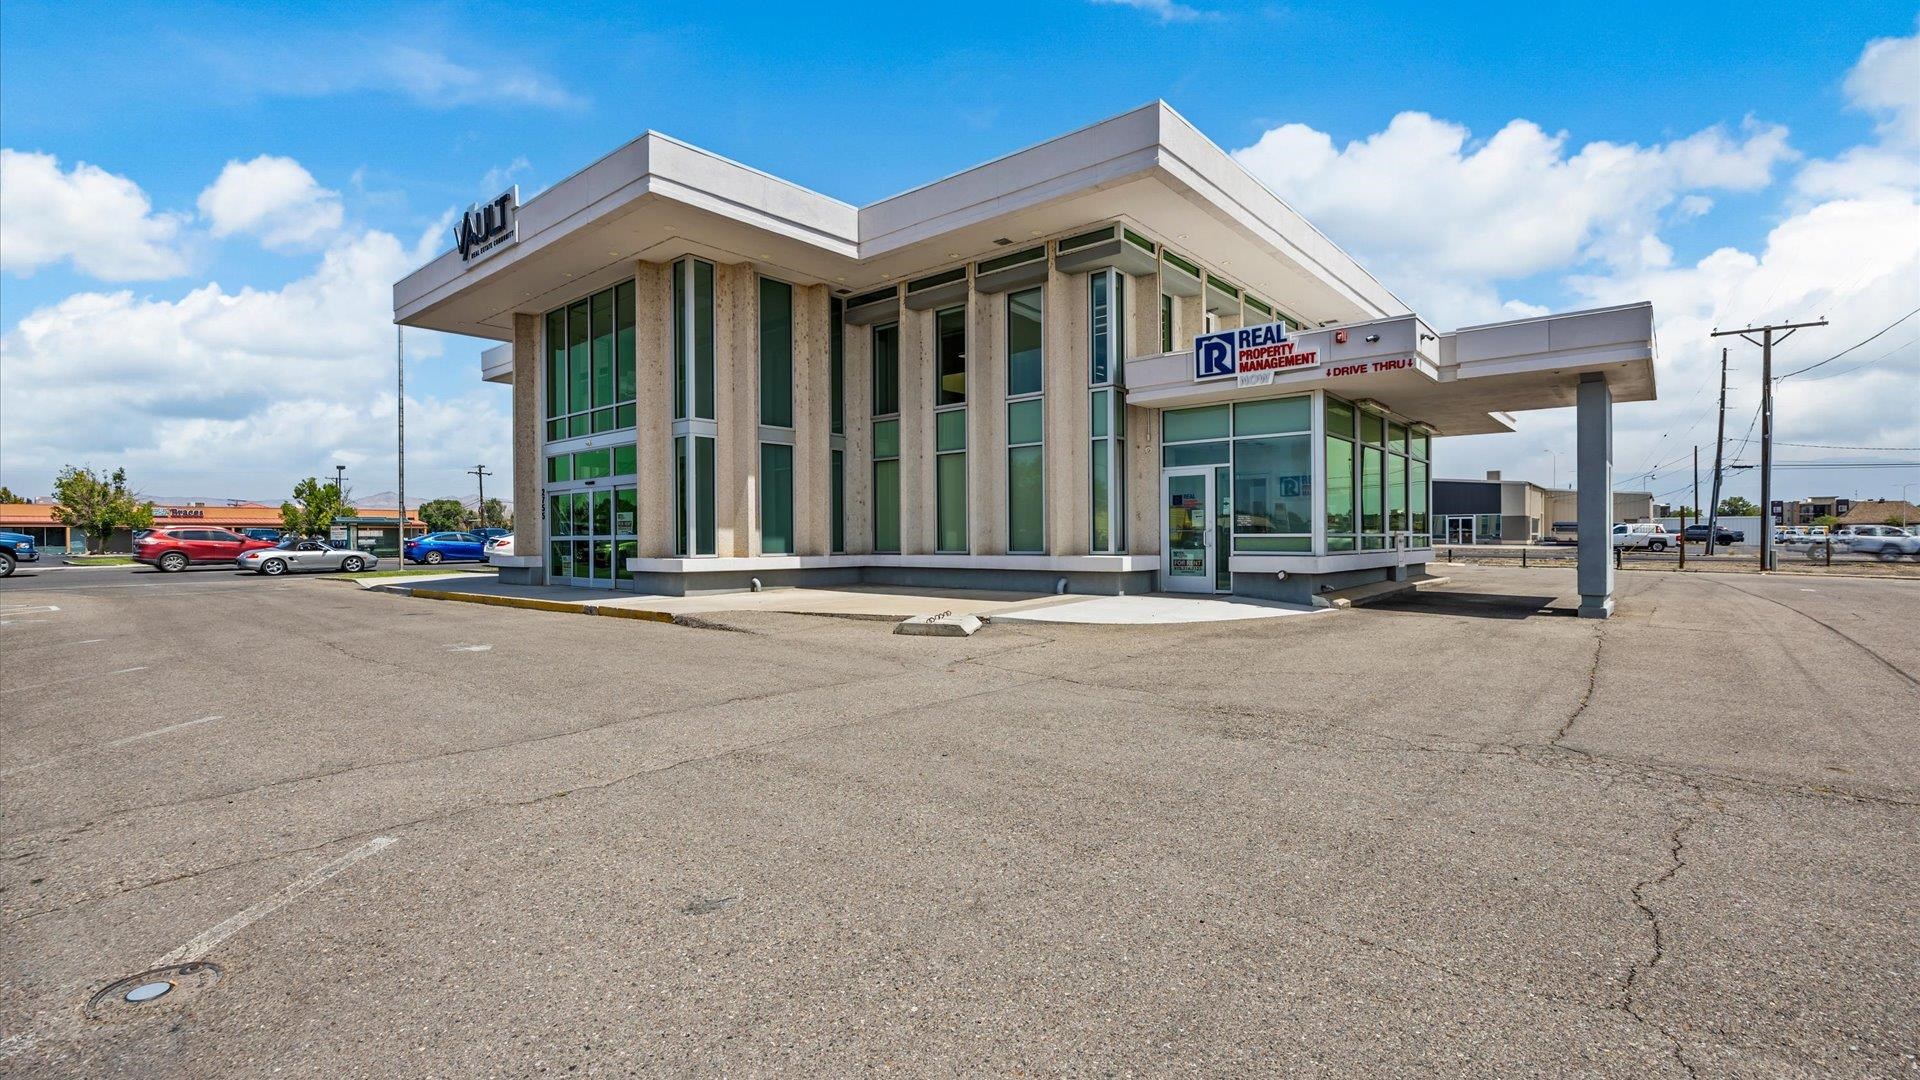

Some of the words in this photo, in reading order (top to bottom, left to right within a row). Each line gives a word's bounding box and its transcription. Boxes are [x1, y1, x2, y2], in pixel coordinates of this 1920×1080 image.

[454, 193, 511, 261] VAULT
[471, 250, 480, 259] REAL
[480, 242, 493, 253] ESTATE
[1239, 324, 1287, 349] REAL
[1239, 343, 1294, 361] PROPERTY
[1239, 352, 1316, 373] MANAGEMENT
[1333, 364, 1368, 377] DRIVE
[1372, 359, 1406, 372] THRU
